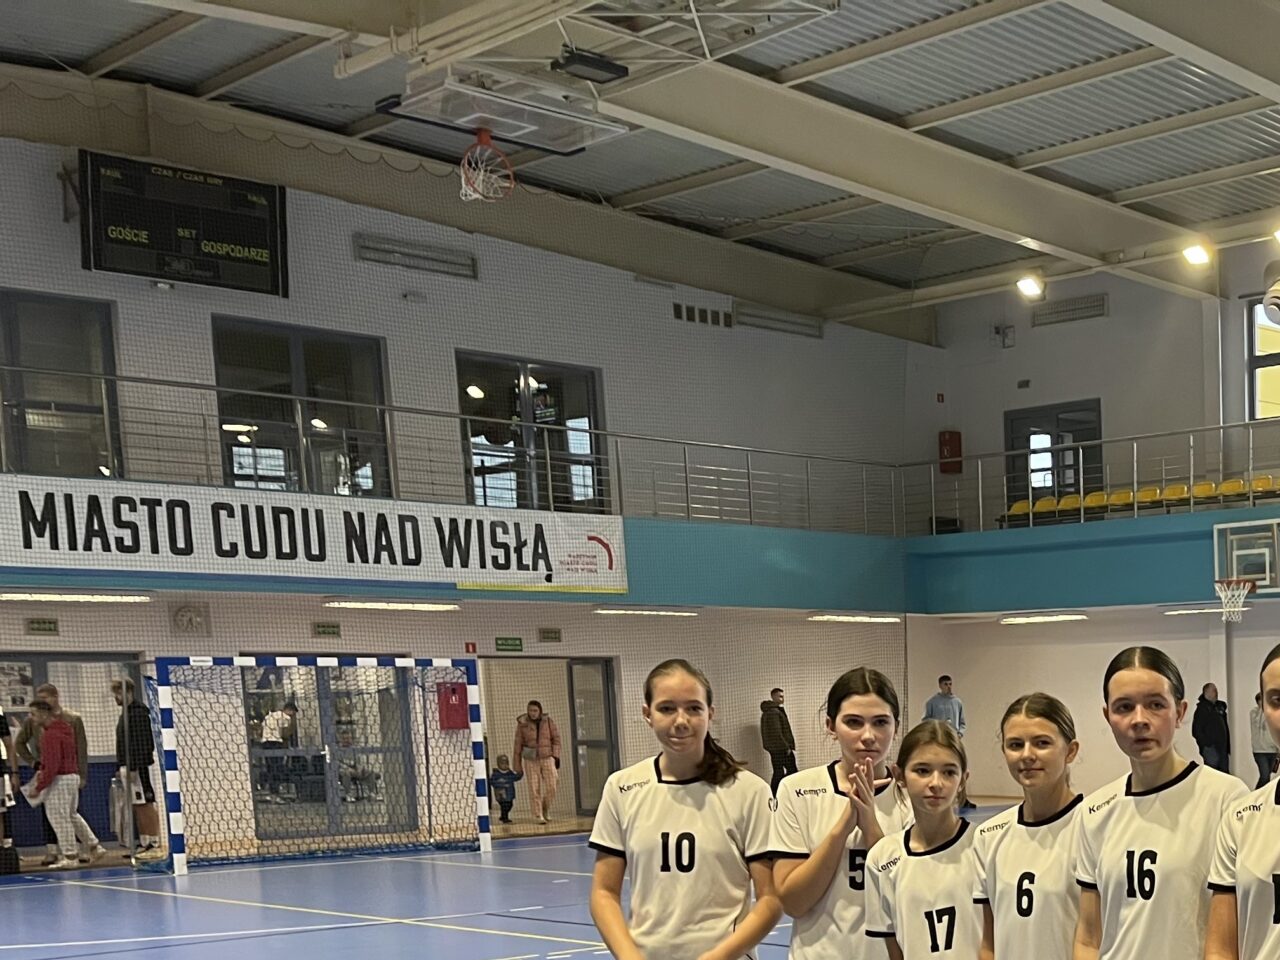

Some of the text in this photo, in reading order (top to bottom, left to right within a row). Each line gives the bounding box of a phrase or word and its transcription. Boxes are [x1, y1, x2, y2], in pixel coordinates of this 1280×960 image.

[107, 225, 149, 243] GOŚCIE
[176, 227, 197, 239] SET
[201, 239, 270, 262] GOSPODARZE
[18, 490, 553, 583] MIASTO CUDU NAD WISŁĄ
[795, 787, 827, 797] Kempa
[660, 832, 696, 872] 10
[849, 849, 867, 890] 5
[1016, 871, 1035, 917] 6
[1126, 850, 1158, 900] 16
[924, 906, 956, 953] 17
